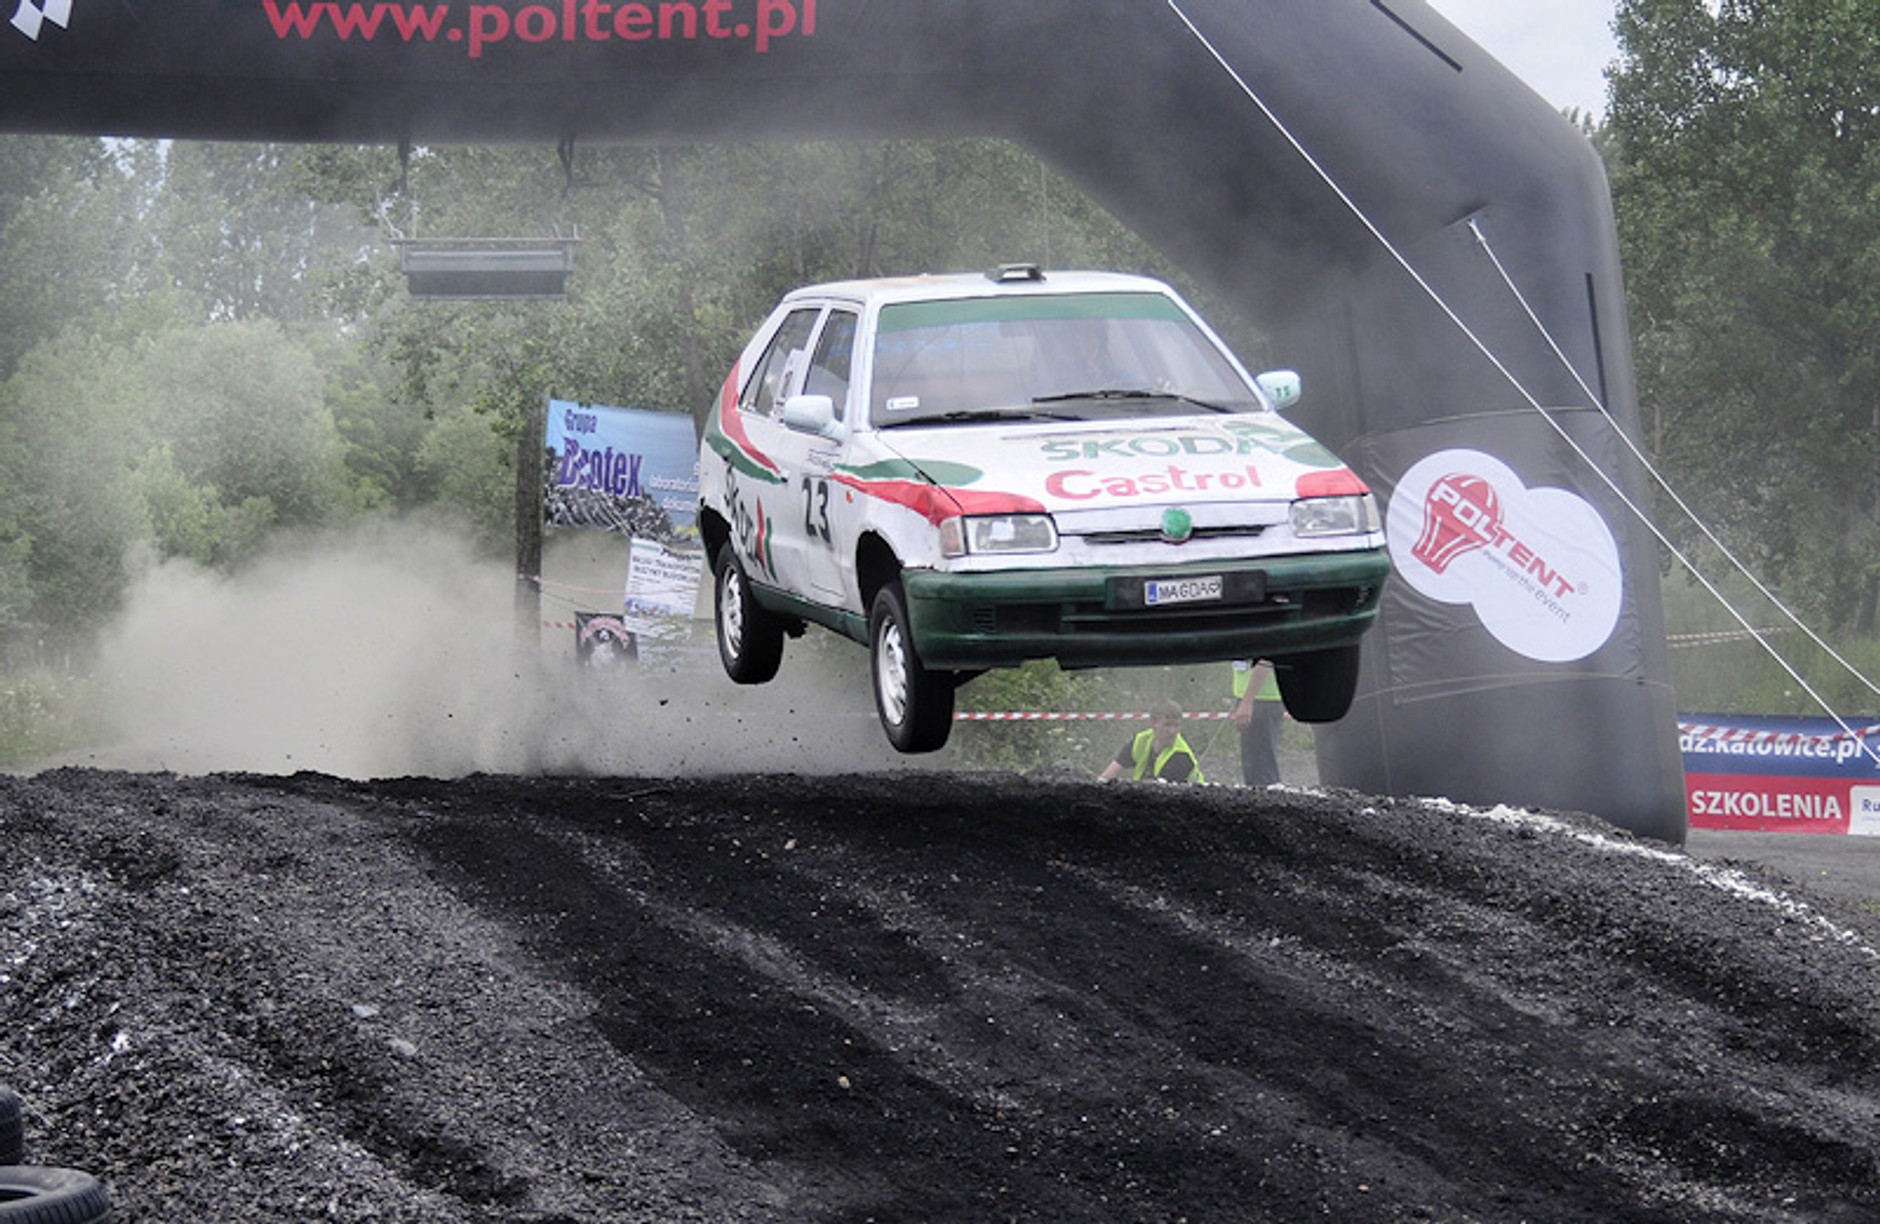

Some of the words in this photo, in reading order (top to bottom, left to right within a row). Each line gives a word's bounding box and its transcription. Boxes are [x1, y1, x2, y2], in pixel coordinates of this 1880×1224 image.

[262, 0, 817, 58] www.poltent.pl
[564, 408, 598, 434] Grupa
[1045, 464, 1263, 500] Castrol
[802, 476, 832, 546] 23
[1431, 481, 1576, 599] POLTENT
[1691, 790, 1843, 819] SZKOLENIA
